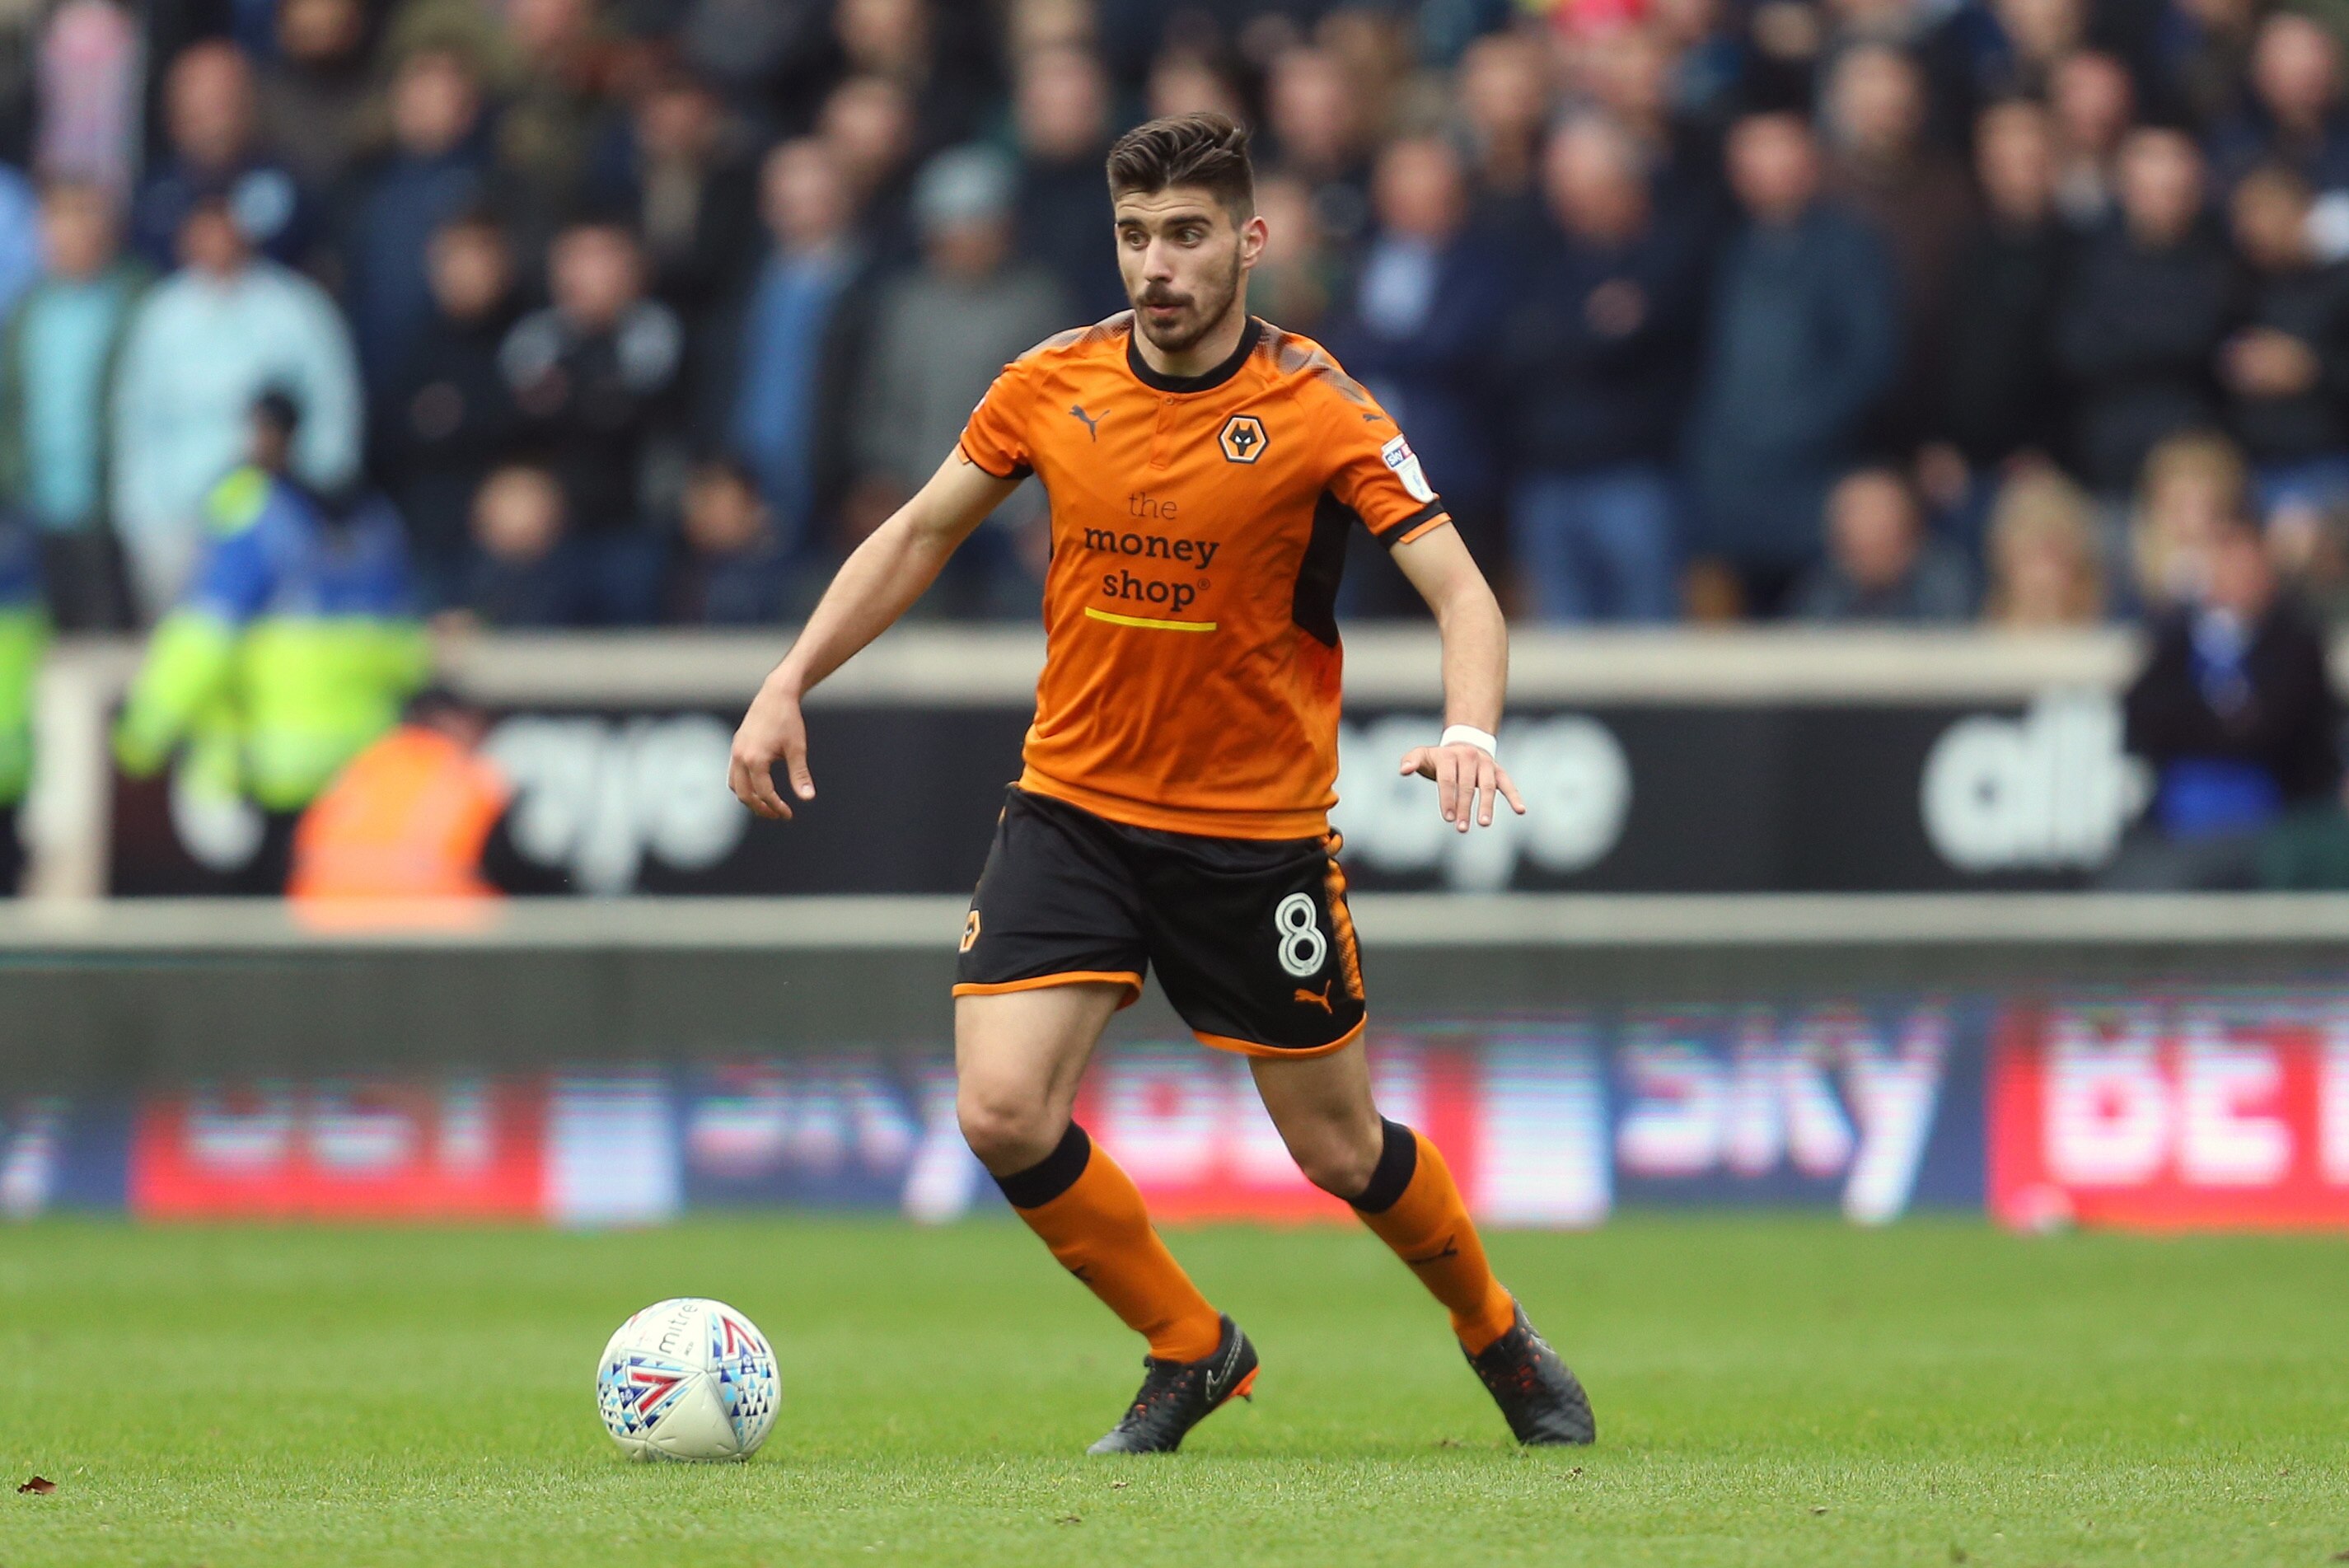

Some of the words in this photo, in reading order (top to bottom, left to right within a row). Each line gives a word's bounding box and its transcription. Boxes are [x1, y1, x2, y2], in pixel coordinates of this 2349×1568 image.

[1128, 491, 1177, 521] the
[1083, 527, 1220, 570] money
[1274, 892, 1328, 977] 8
[658, 1304, 699, 1355] mitre
